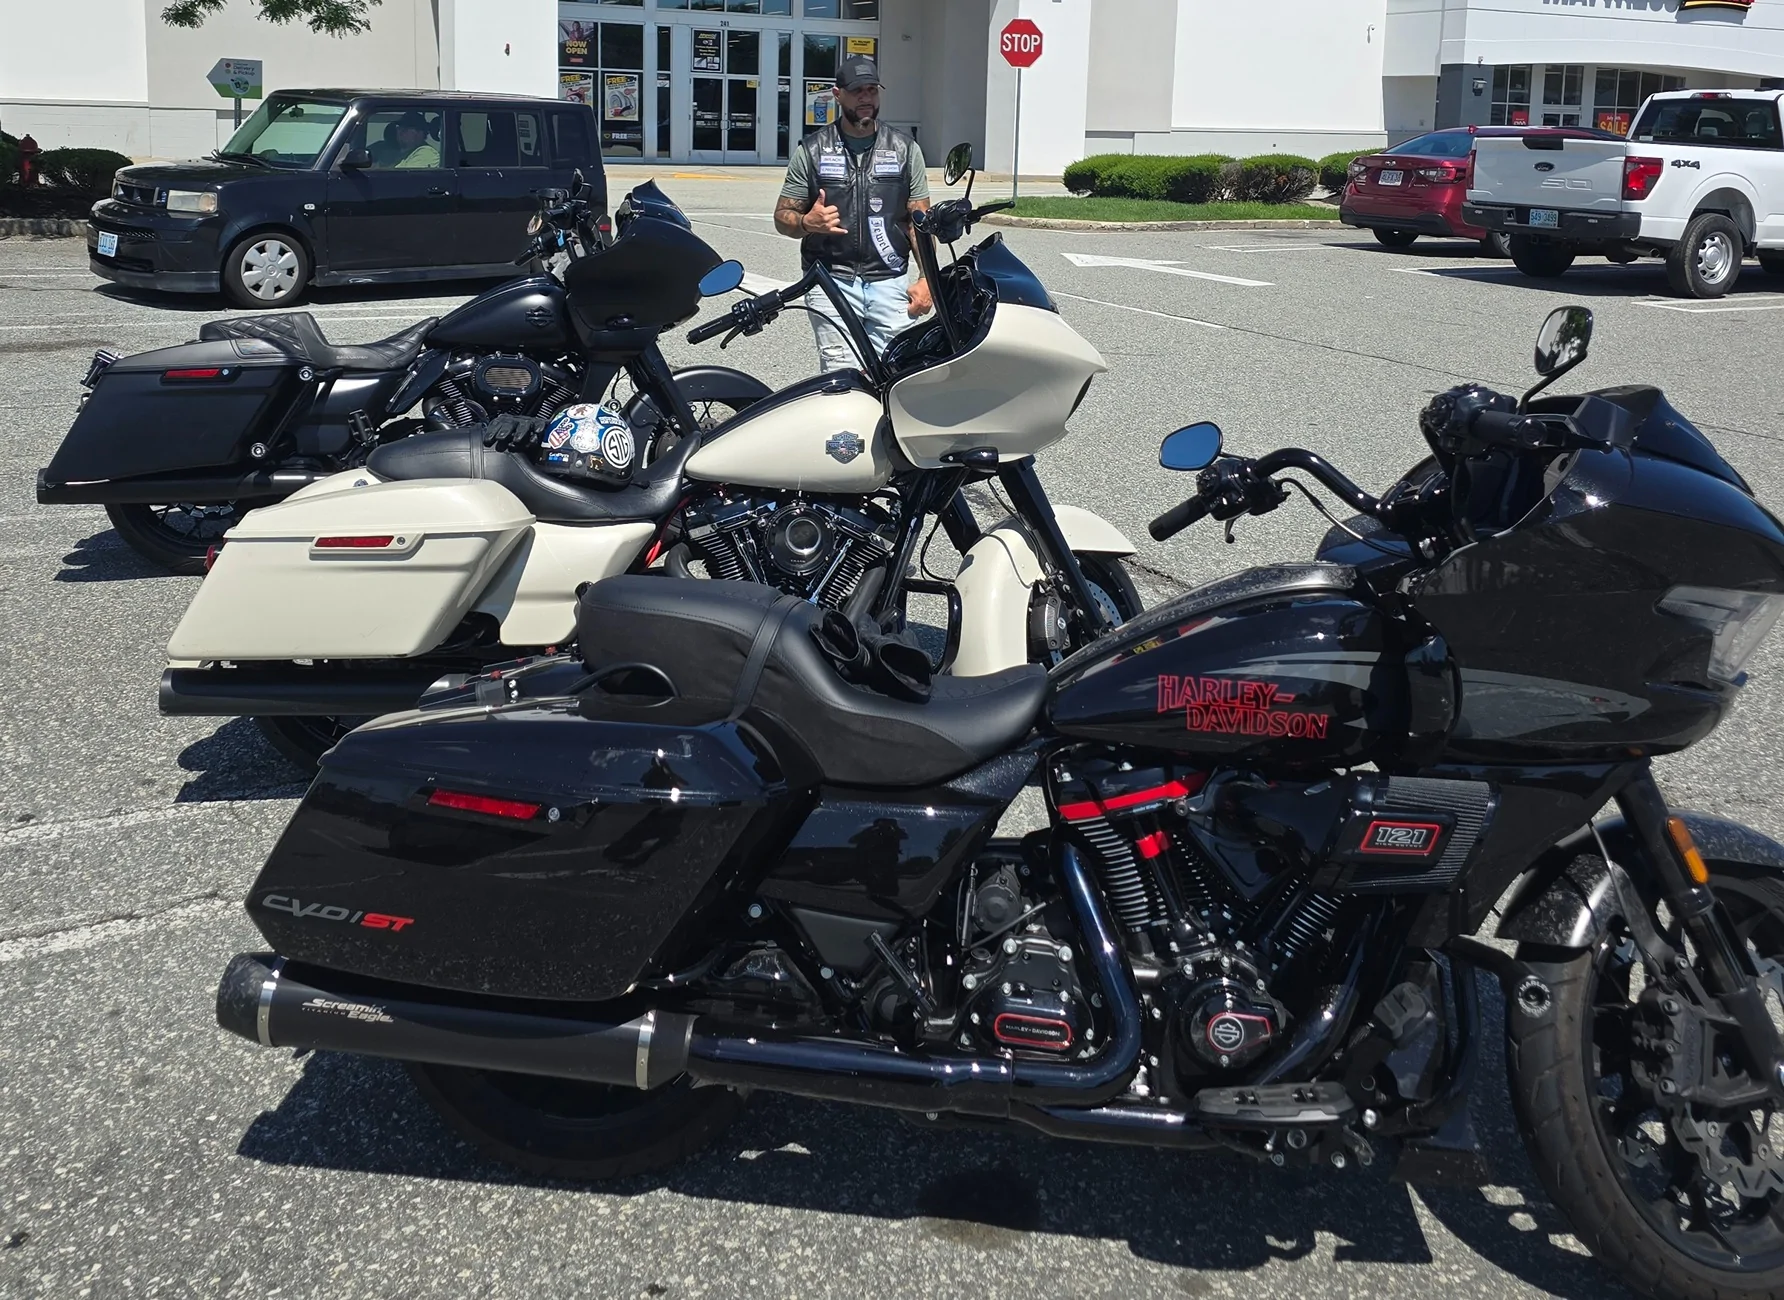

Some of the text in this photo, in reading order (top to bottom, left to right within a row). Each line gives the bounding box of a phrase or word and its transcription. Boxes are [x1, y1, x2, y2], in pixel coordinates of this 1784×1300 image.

[566, 40, 587, 48] NOW
[1002, 33, 1041, 53] STOP
[565, 47, 588, 55] OPEN
[560, 74, 581, 83] FREE
[606, 76, 627, 85] FREE
[1600, 121, 1628, 134] SALE
[871, 219, 890, 252] Jewel
[608, 432, 629, 461] SIG
[1186, 703, 1329, 739] DAVIDSON
[1376, 826, 1426, 845] 121
[262, 894, 415, 932] CVO ST
[1519, 980, 1550, 993] HARLEY
[347, 1010, 394, 1023] Eagle
